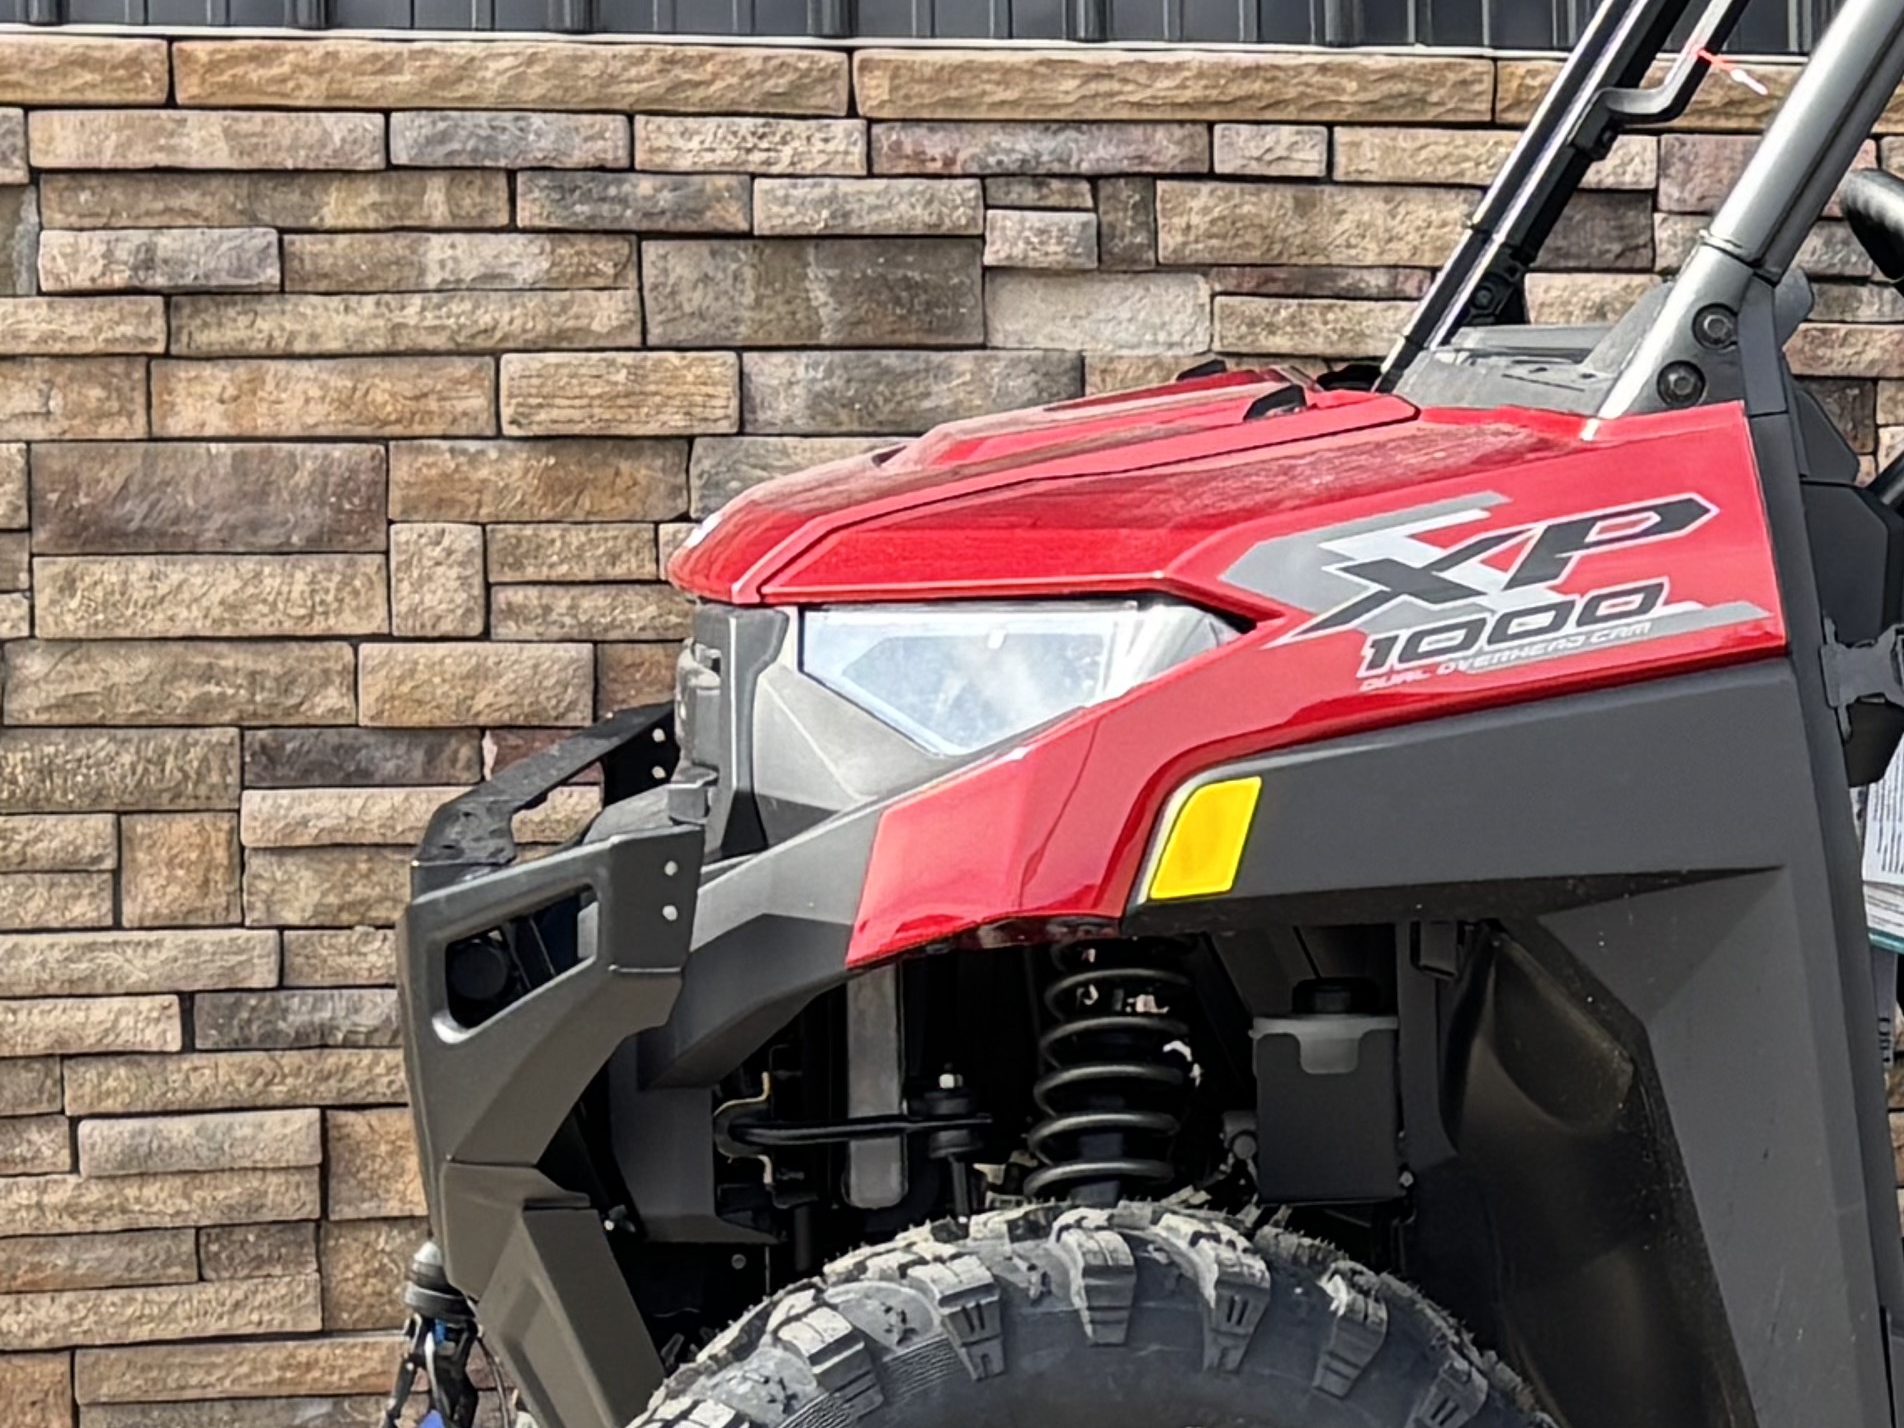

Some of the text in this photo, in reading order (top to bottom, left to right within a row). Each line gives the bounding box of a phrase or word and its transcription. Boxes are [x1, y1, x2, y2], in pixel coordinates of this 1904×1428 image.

[1265, 493, 1719, 647] XP
[1357, 577, 1669, 677] 1000
[1360, 622, 1653, 692] DUAL OVERHEAD CAM
